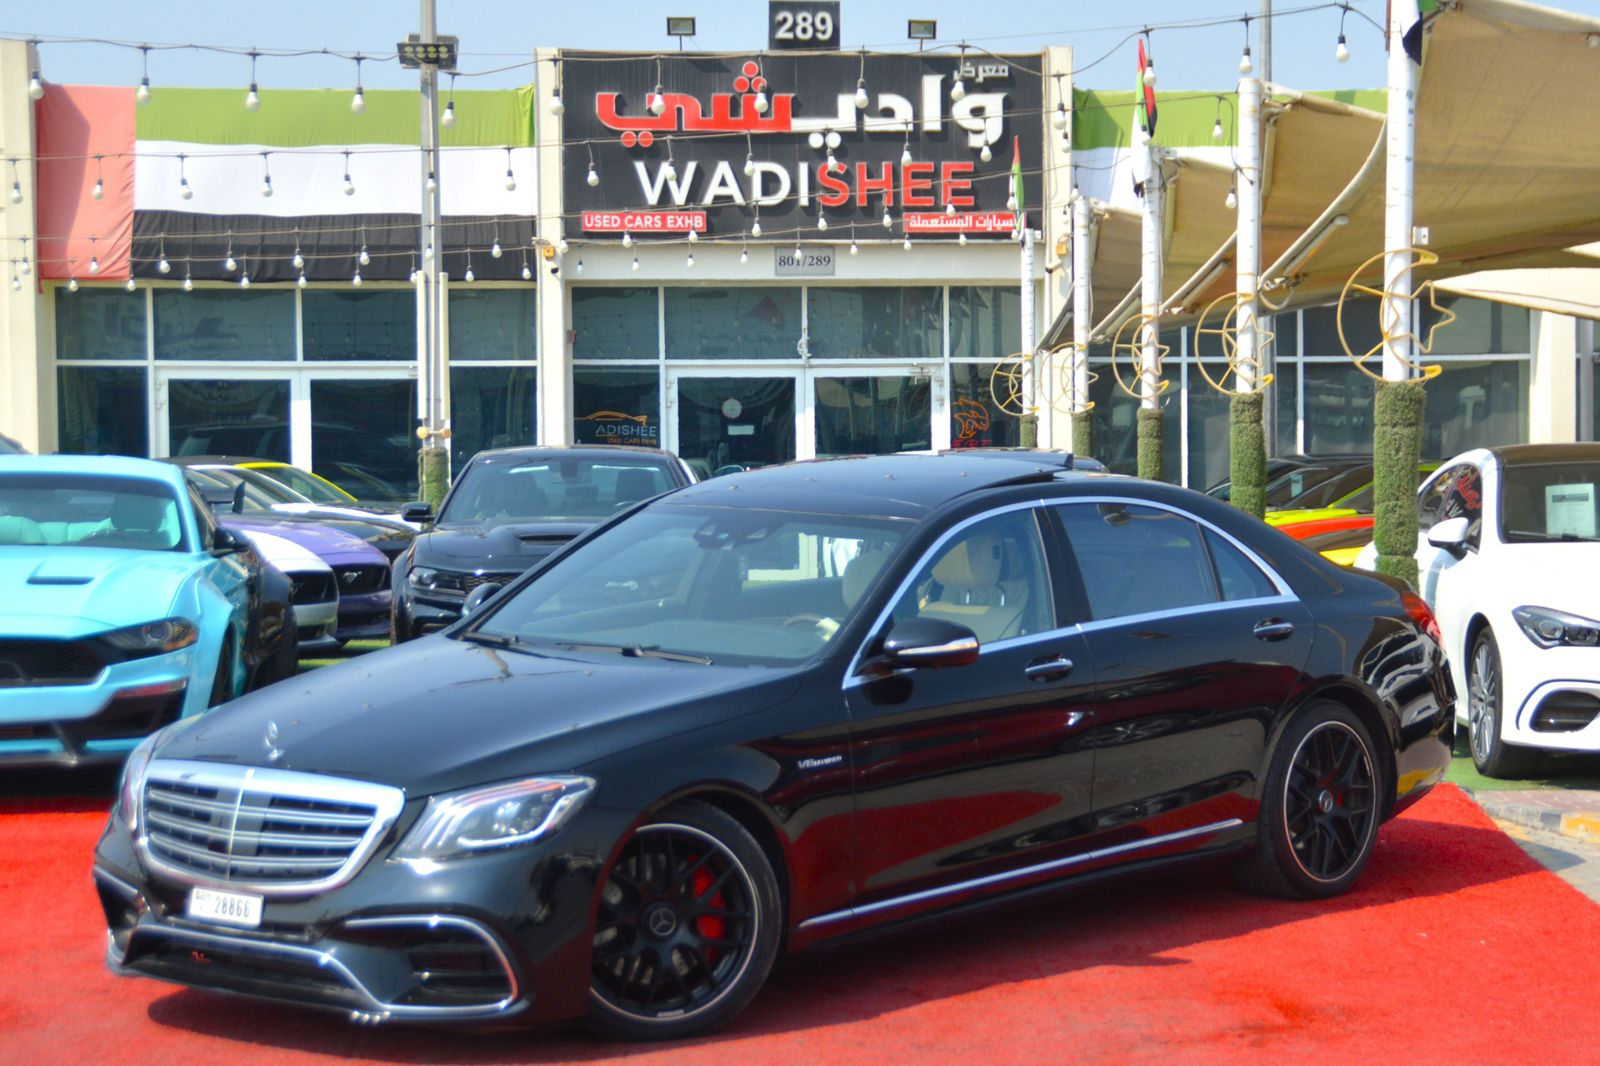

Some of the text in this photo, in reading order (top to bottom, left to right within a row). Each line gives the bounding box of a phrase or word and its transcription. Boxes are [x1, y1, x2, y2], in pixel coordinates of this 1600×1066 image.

[775, 11, 833, 40] 289
[953, 62, 1009, 83] معرض
[633, 160, 975, 206] WADISHEE
[584, 215, 704, 228] USED CARS EXHB
[975, 214, 1018, 231] لسيارات
[778, 255, 831, 267] 801/289
[214, 895, 250, 918] 28866
